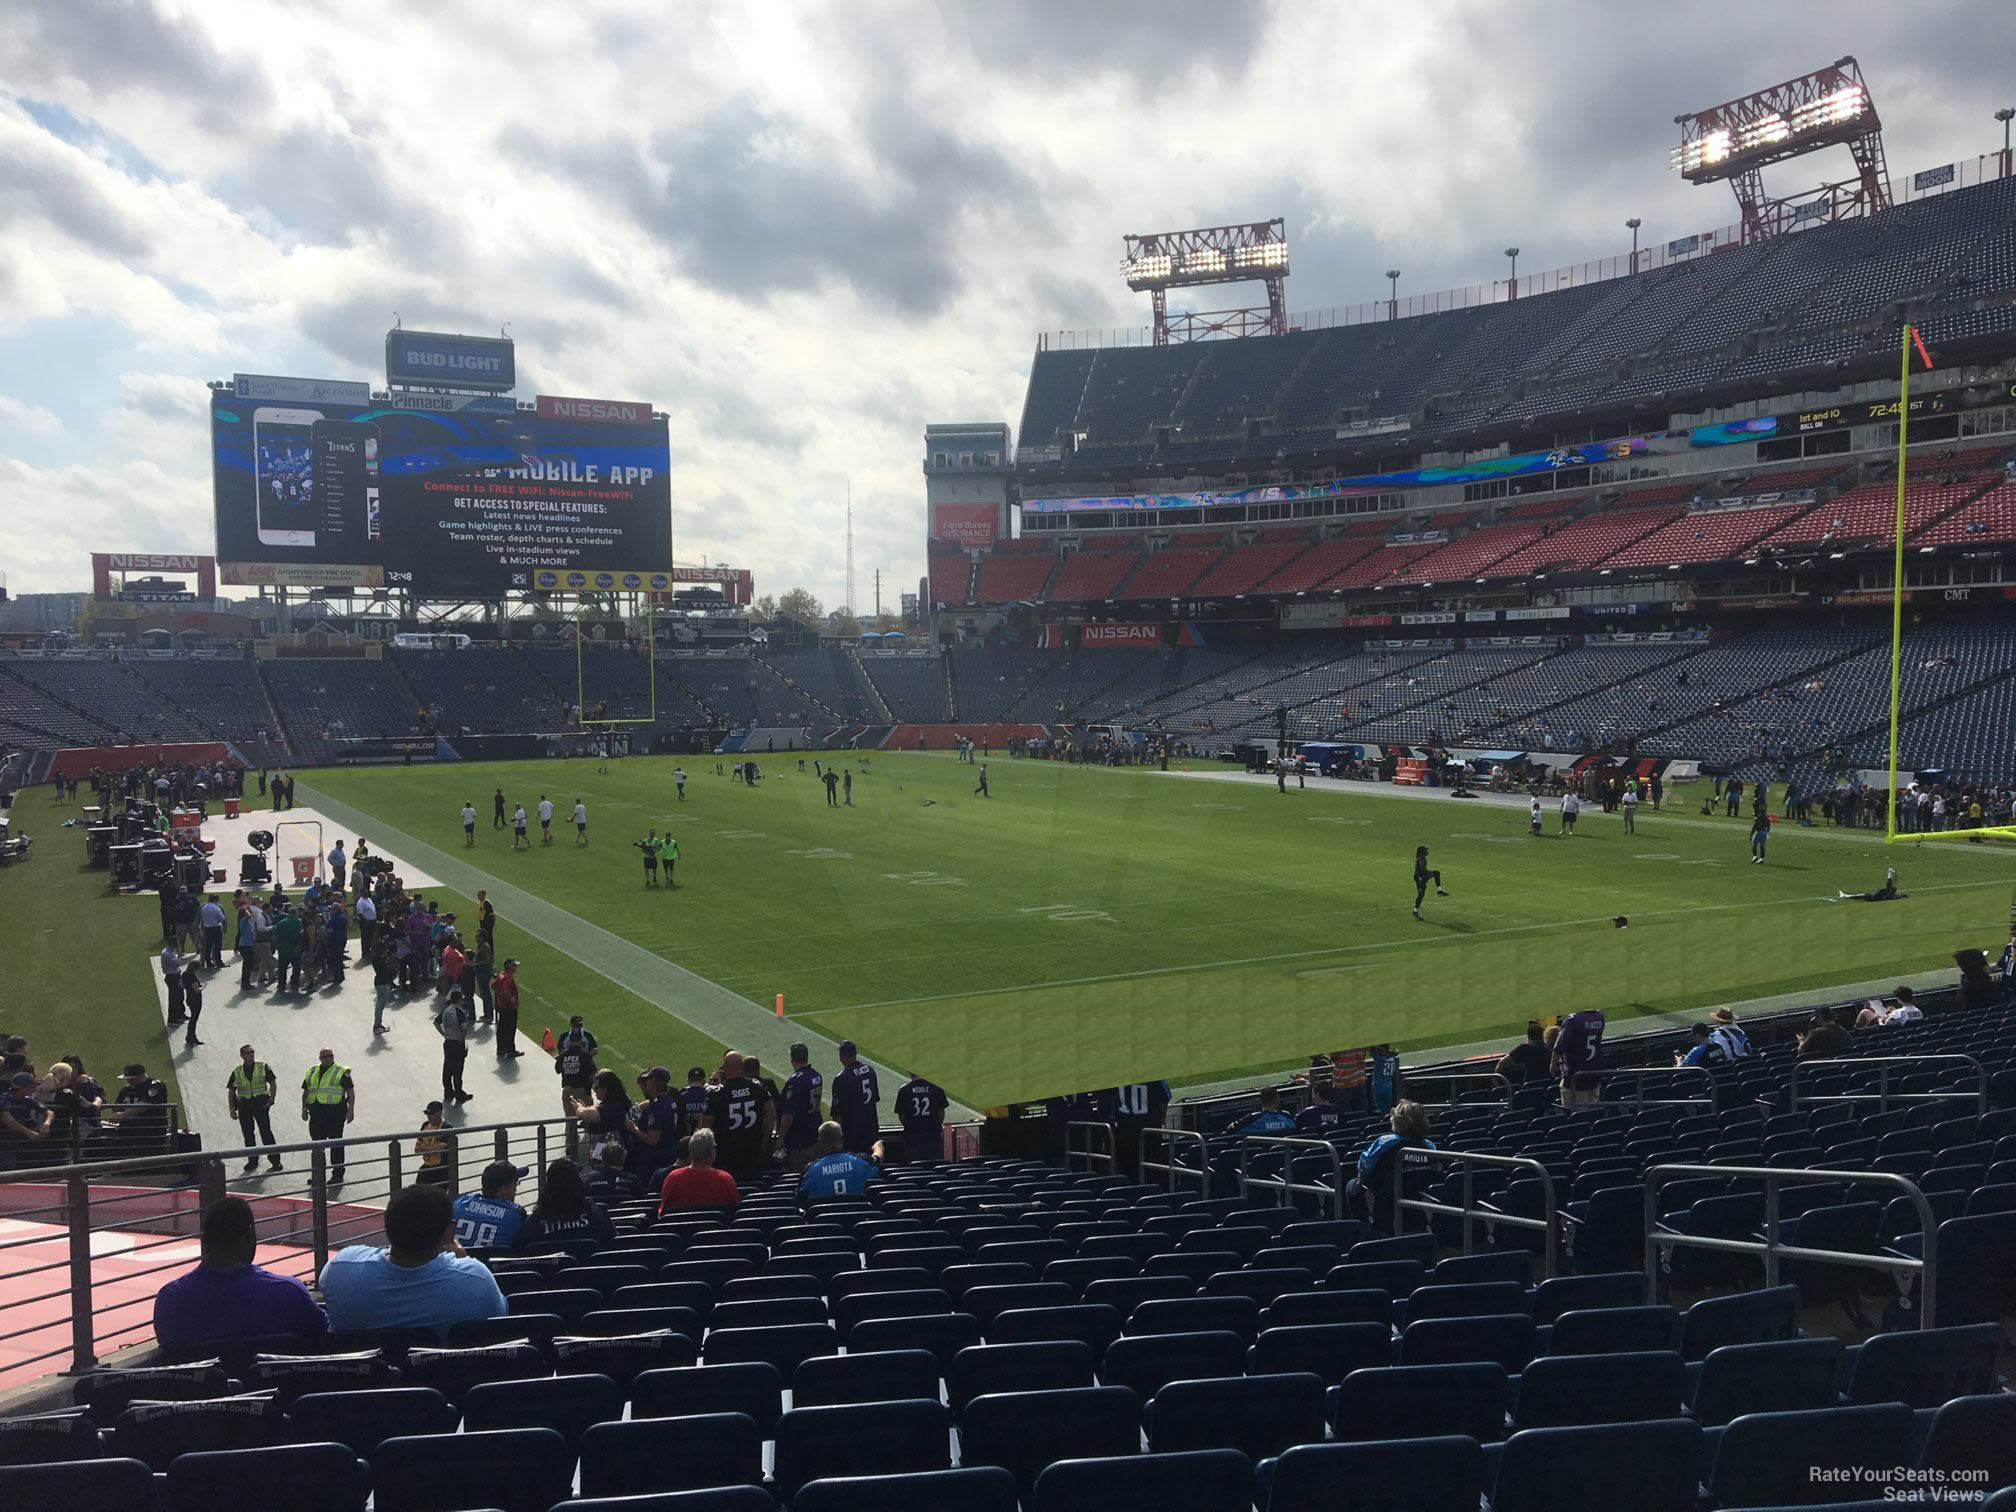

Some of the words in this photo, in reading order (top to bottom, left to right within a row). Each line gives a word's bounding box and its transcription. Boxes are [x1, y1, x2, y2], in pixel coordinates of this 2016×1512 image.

[1916, 173, 1951, 189] MOON
[407, 351, 446, 367] BUD
[448, 354, 501, 371] LIGHT
[394, 393, 453, 410] Pinnacle
[554, 401, 637, 420] NISSAN
[1812, 411, 1829, 420] and
[610, 465, 653, 486] APP
[424, 481, 471, 493] Connect
[474, 483, 486, 493] to
[489, 485, 515, 494] FREE
[454, 498, 471, 508] GET
[474, 498, 508, 510] ACCESS
[509, 500, 521, 510] TO
[523, 500, 559, 512] SPECIAL
[561, 502, 607, 514] FEATURES:
[483, 511, 511, 520] Latest
[538, 513, 581, 522] headlines
[438, 520, 466, 529] Game
[468, 521, 512, 532] highlights
[515, 523, 522, 531] &
[524, 524, 543, 532] LIVE
[571, 526, 623, 535] conferences
[449, 532, 474, 541] Team
[476, 534, 505, 543] roster,
[507, 534, 534, 543] depth
[536, 535, 563, 544] charts
[566, 536, 573, 544] &
[575, 537, 614, 546] schedule
[486, 544, 504, 553] Live
[506, 545, 553, 554] in-stadium
[555, 546, 580, 555] views
[109, 554, 198, 568] NISSAN
[500, 556, 507, 564] &
[509, 556, 538, 565] MUCH
[540, 557, 567, 566] MORE
[674, 569, 739, 581] NISSAN
[1872, 592, 1911, 601] PRODUTS
[1944, 590, 1970, 600] CMT
[1086, 626, 1156, 639] NISSAN
[298, 862, 308, 873] G
[1586, 1035, 1596, 1061] 5
[853, 1065, 870, 1077] FLACCO
[731, 1088, 751, 1098] SUGGS
[861, 1078, 872, 1104] 5
[912, 1097, 930, 1116] 32
[1118, 1084, 1148, 1114] 10
[729, 1100, 757, 1130] 55
[822, 1161, 854, 1176] MARIOTA
[464, 1201, 506, 1219] JOHNSON
[540, 1213, 589, 1235] TITANS
[455, 1218, 498, 1247] 28
[148, 1402, 252, 1419] www.TitansSeats.com
